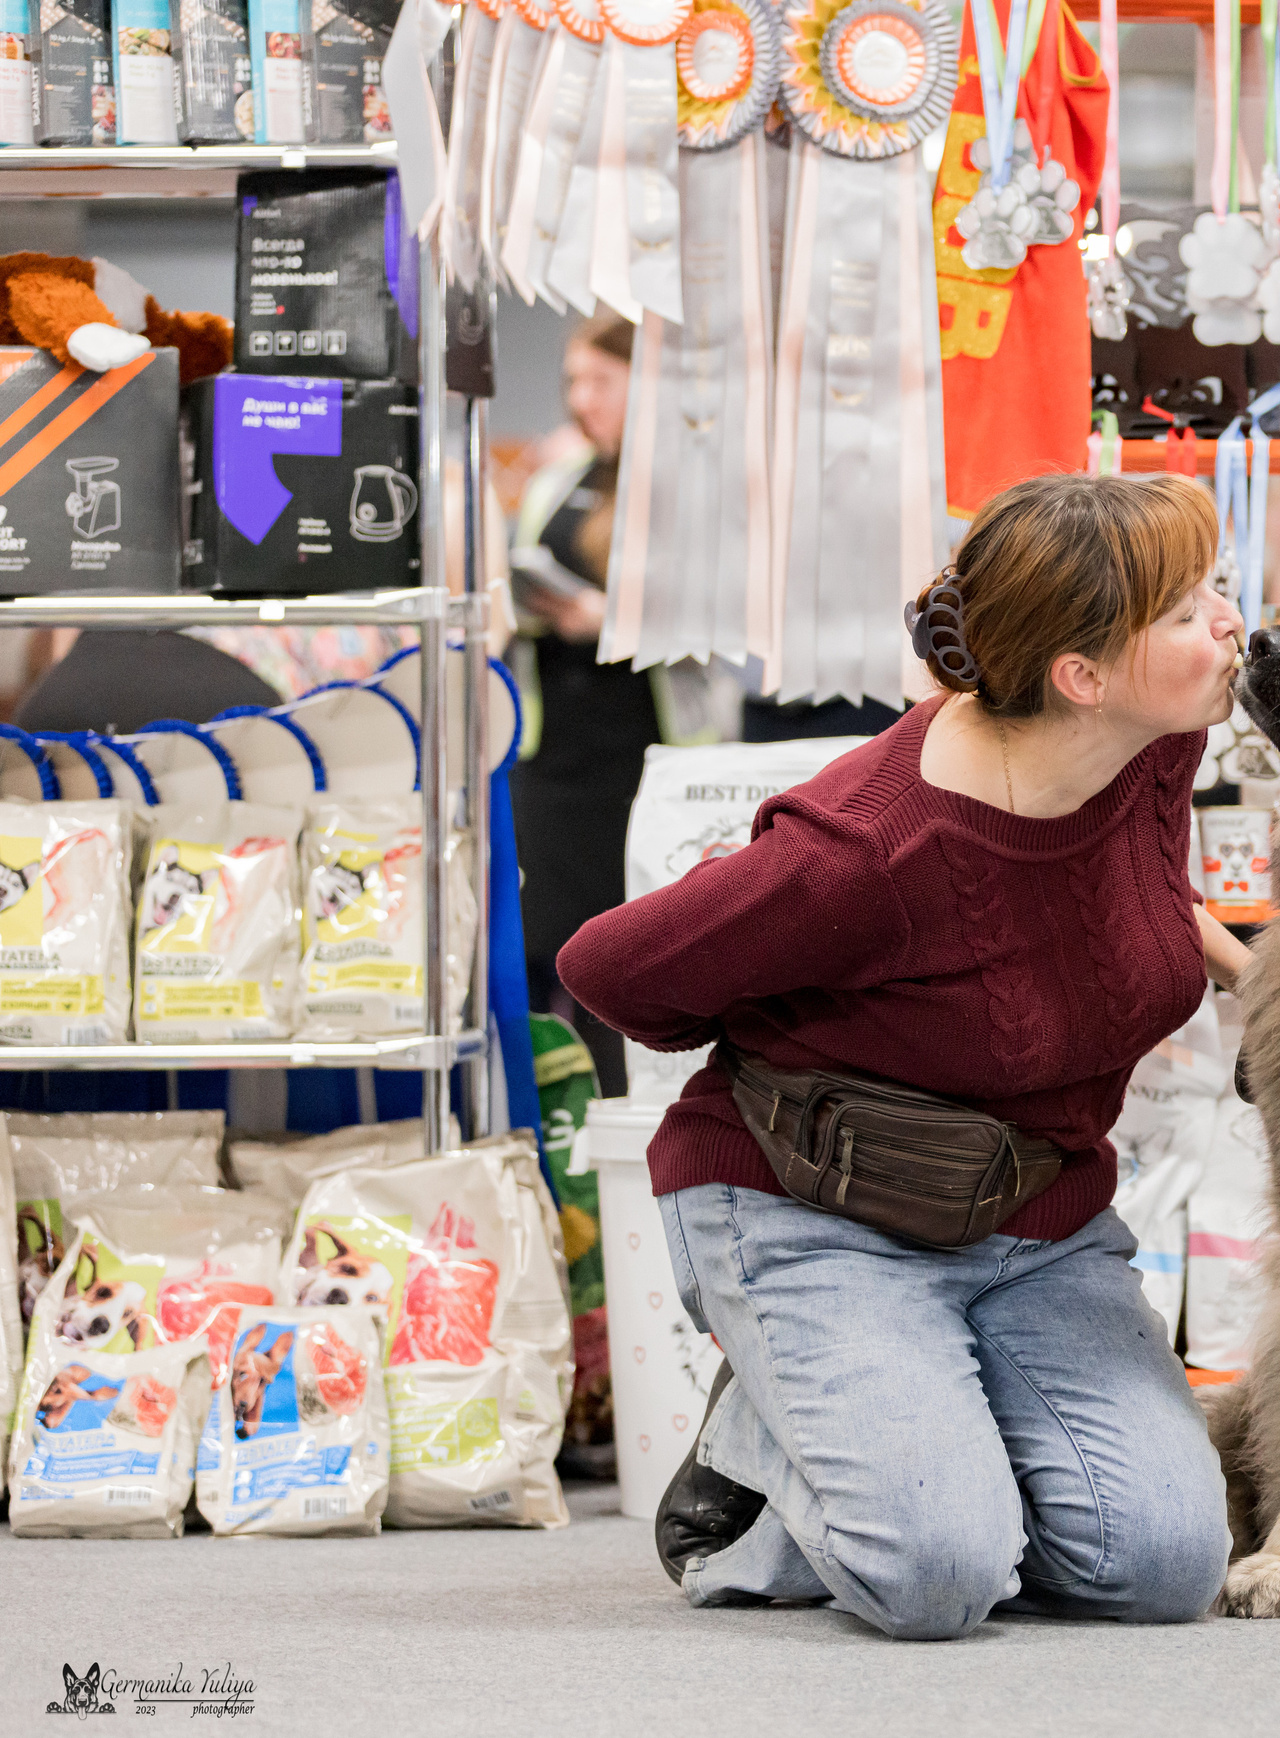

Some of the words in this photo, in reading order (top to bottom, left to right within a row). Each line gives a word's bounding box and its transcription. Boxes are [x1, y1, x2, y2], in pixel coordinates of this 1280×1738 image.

[252, 237, 305, 252] Всегда
[251, 256, 302, 269] что-то
[251, 270, 338, 286] новенькое!
[242, 397, 287, 414] Души
[287, 401, 299, 414] в
[300, 399, 328, 415] вас
[242, 415, 263, 428] не
[685, 784, 741, 801] BEST
